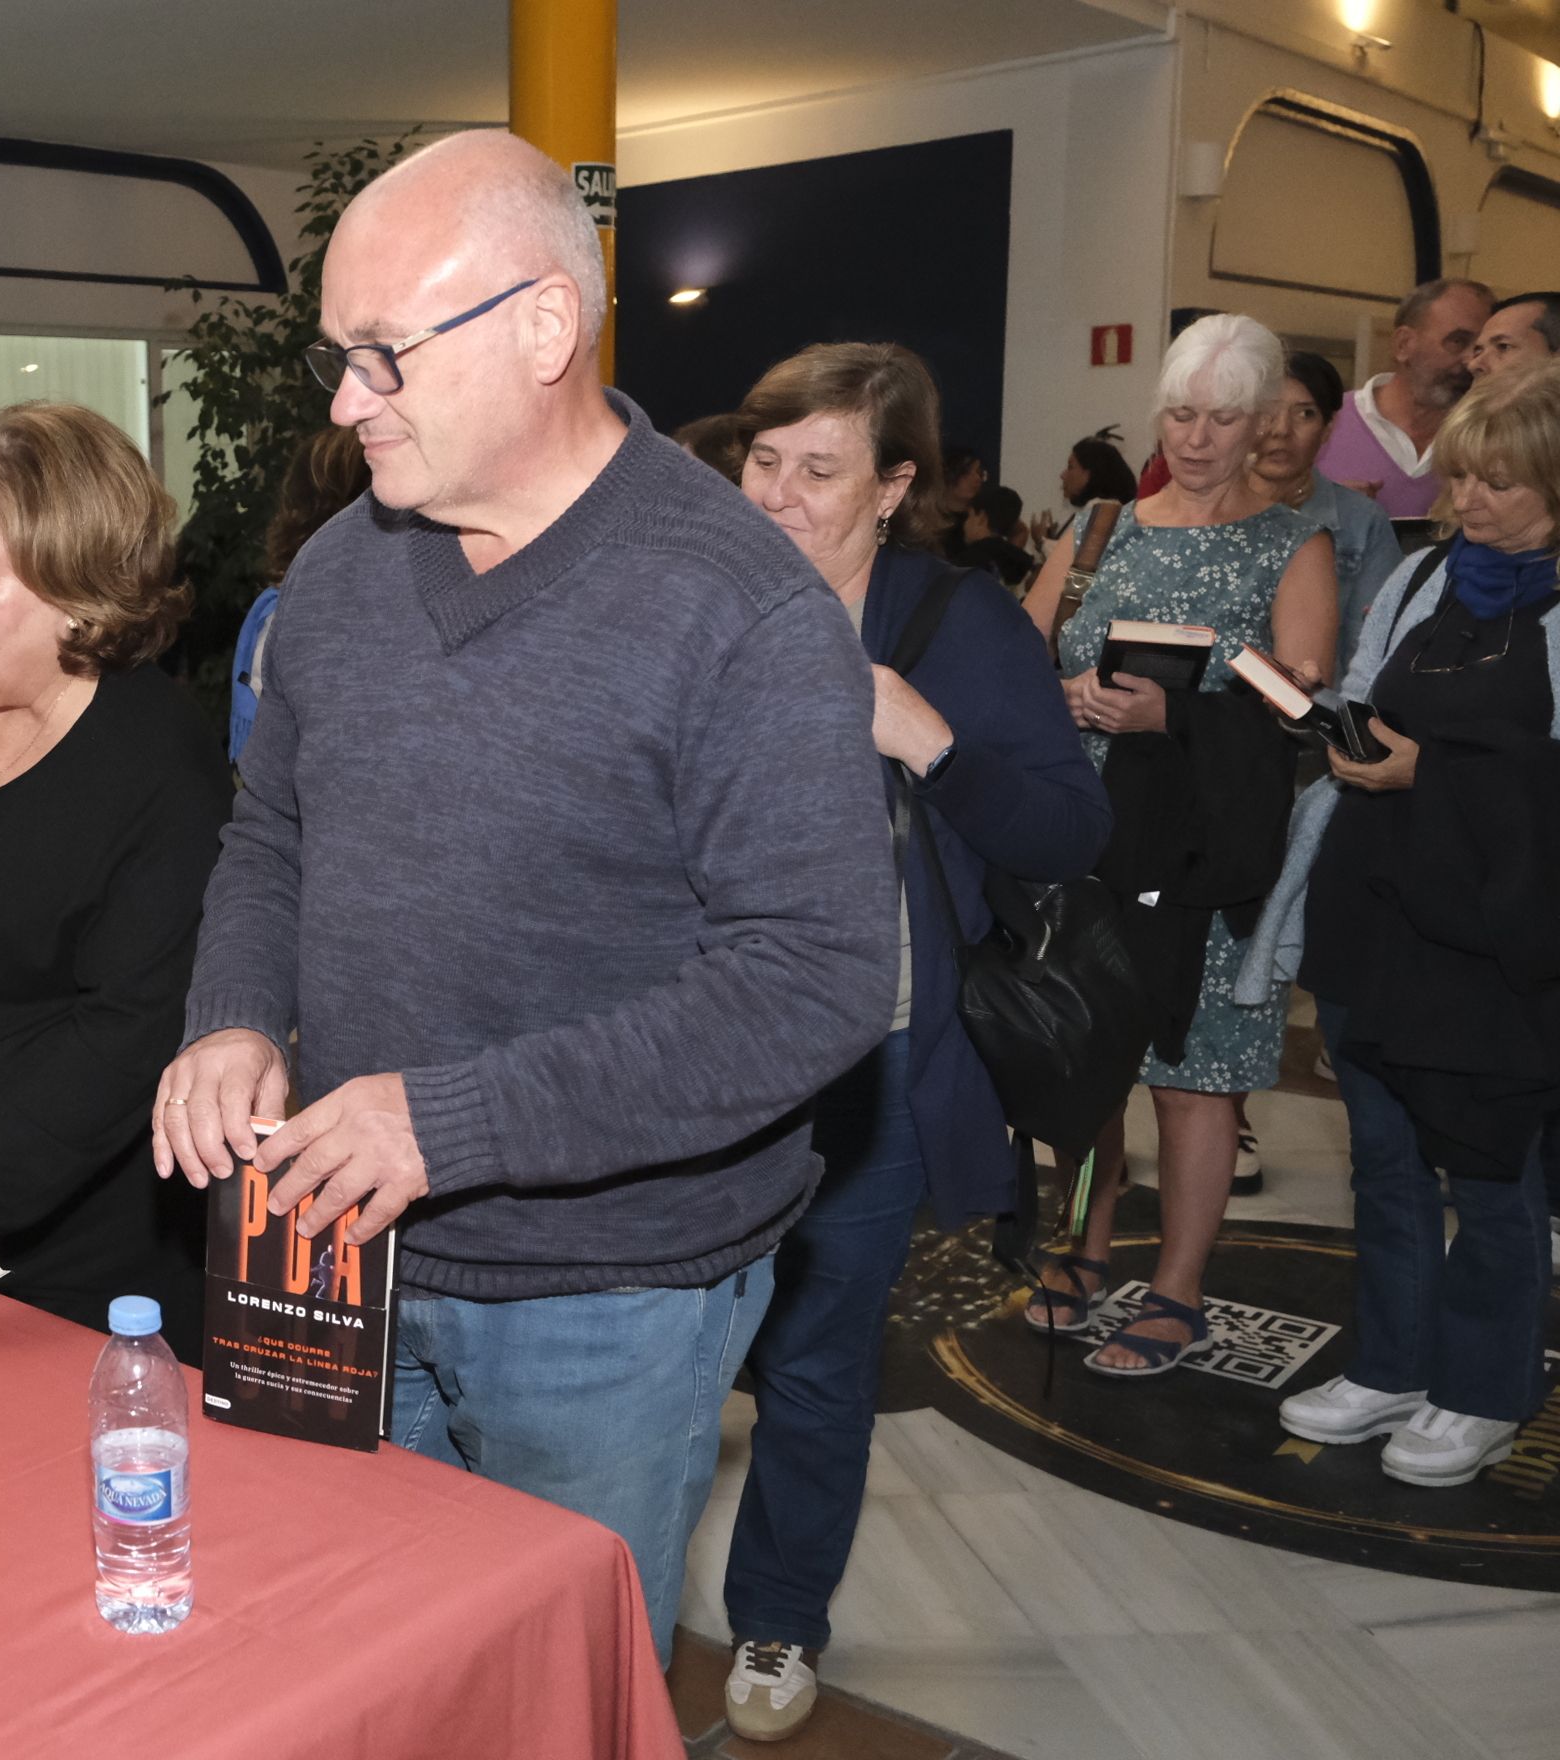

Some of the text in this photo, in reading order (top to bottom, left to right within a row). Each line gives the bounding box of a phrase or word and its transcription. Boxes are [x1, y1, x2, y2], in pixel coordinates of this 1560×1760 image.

[227, 1290, 364, 1329] LORENZO SILVA
[212, 1336, 240, 1349] TRAS
[243, 1344, 286, 1360] CRUZAR
[289, 1355, 303, 1364] LA
[342, 1365, 378, 1378] ROJA?
[287, 1342, 331, 1358] OCURRE
[230, 1361, 240, 1370] Un
[241, 1364, 266, 1376] thriller
[292, 1376, 338, 1391] estremecedor
[339, 1386, 360, 1396] sobre
[235, 1372, 242, 1380] la
[242, 1375, 266, 1386] guerra
[266, 1380, 284, 1390] sucia
[304, 1389, 354, 1404] consecuencias
